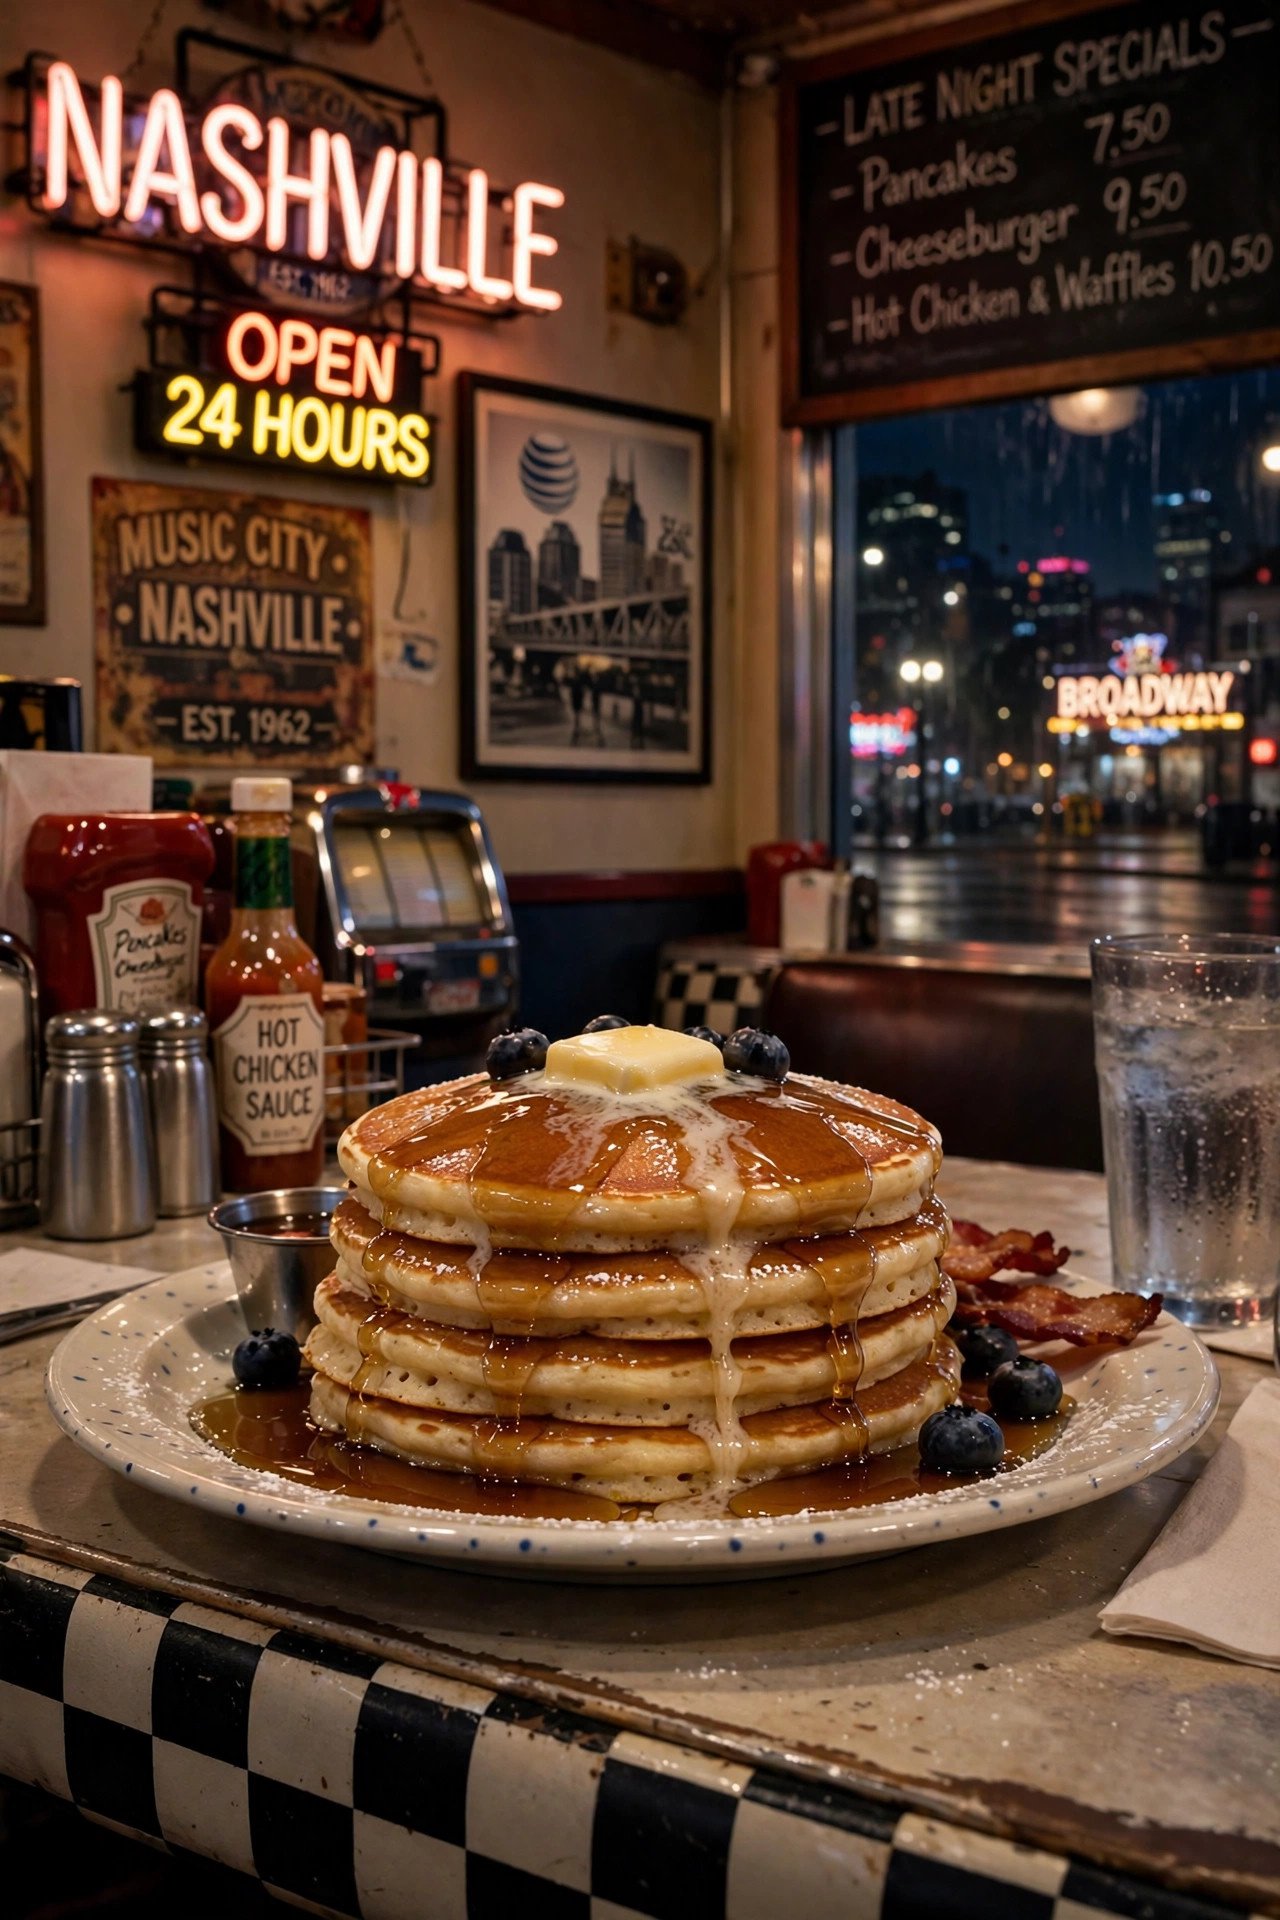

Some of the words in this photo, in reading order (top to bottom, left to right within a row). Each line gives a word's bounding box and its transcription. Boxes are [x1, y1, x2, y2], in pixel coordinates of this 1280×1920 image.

[844, 82, 925, 146] LATE
[936, 52, 1043, 122] NIGHT
[1053, 10, 1226, 97] SPECIALS
[46, 62, 565, 310] NASHVILLE
[859, 140, 1018, 213] Pancakes
[1084, 102, 1171, 164] 7.50
[856, 203, 1079, 278] Cheeseburger
[1103, 172, 1187, 233] 9.50
[852, 294, 904, 344] Hot
[910, 280, 1020, 334] Chicken
[1028, 275, 1050, 315] &
[1056, 251, 1176, 311] Waffles
[1188, 233, 1274, 293] 10.50
[226, 311, 397, 402] OPEN
[163, 375, 241, 448] 24
[253, 389, 430, 477] HOURS
[118, 510, 236, 575] MUSIC
[245, 515, 329, 580] CITY
[140, 580, 344, 653] NASHVILLE
[182, 704, 240, 742] EST.
[248, 707, 311, 744] 1962
[1057, 671, 1234, 718] BROADWAY
[233, 1051, 318, 1084] CHICKEN
[258, 1018, 300, 1048] HOT
[246, 1088, 312, 1119] SAUCE
